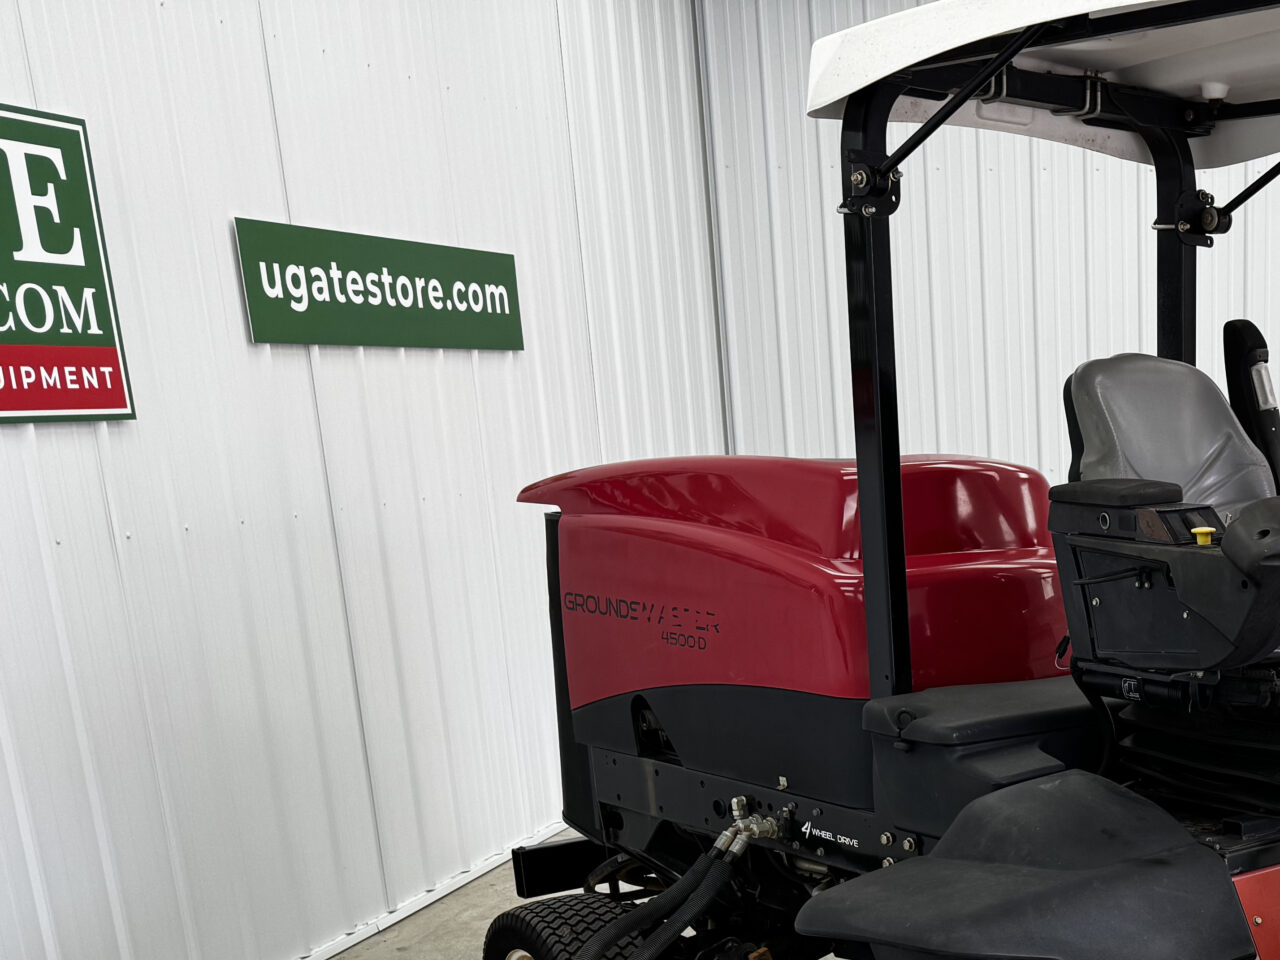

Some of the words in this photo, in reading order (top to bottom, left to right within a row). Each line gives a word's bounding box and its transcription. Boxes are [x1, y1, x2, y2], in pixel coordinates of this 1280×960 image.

[259, 261, 510, 315] ugatestore.com
[801, 821, 812, 839] 4
[811, 828, 836, 842] WHEEL
[837, 834, 859, 848] DRIVE
